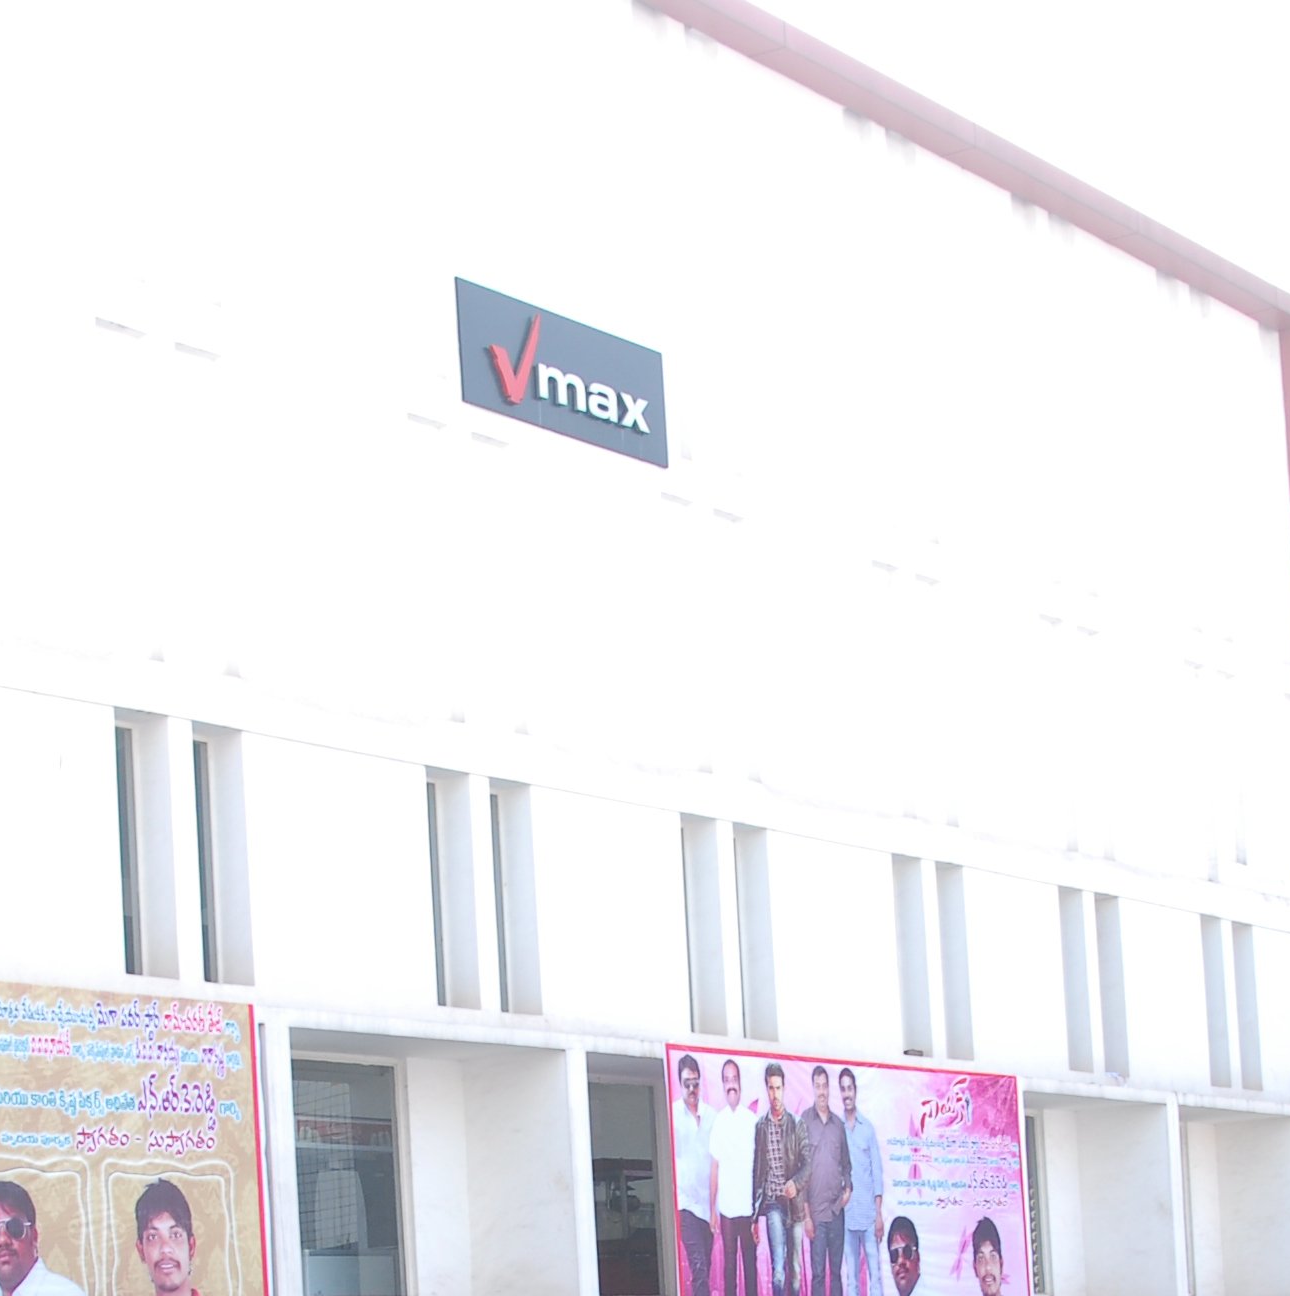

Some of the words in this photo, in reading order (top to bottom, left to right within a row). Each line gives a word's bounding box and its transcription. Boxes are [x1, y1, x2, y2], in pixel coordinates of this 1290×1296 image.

[489, 313, 650, 434] Vmax
[76, 1126, 130, 1153] స్వాగతం
[148, 1130, 215, 1155] సుస్వాగతం
